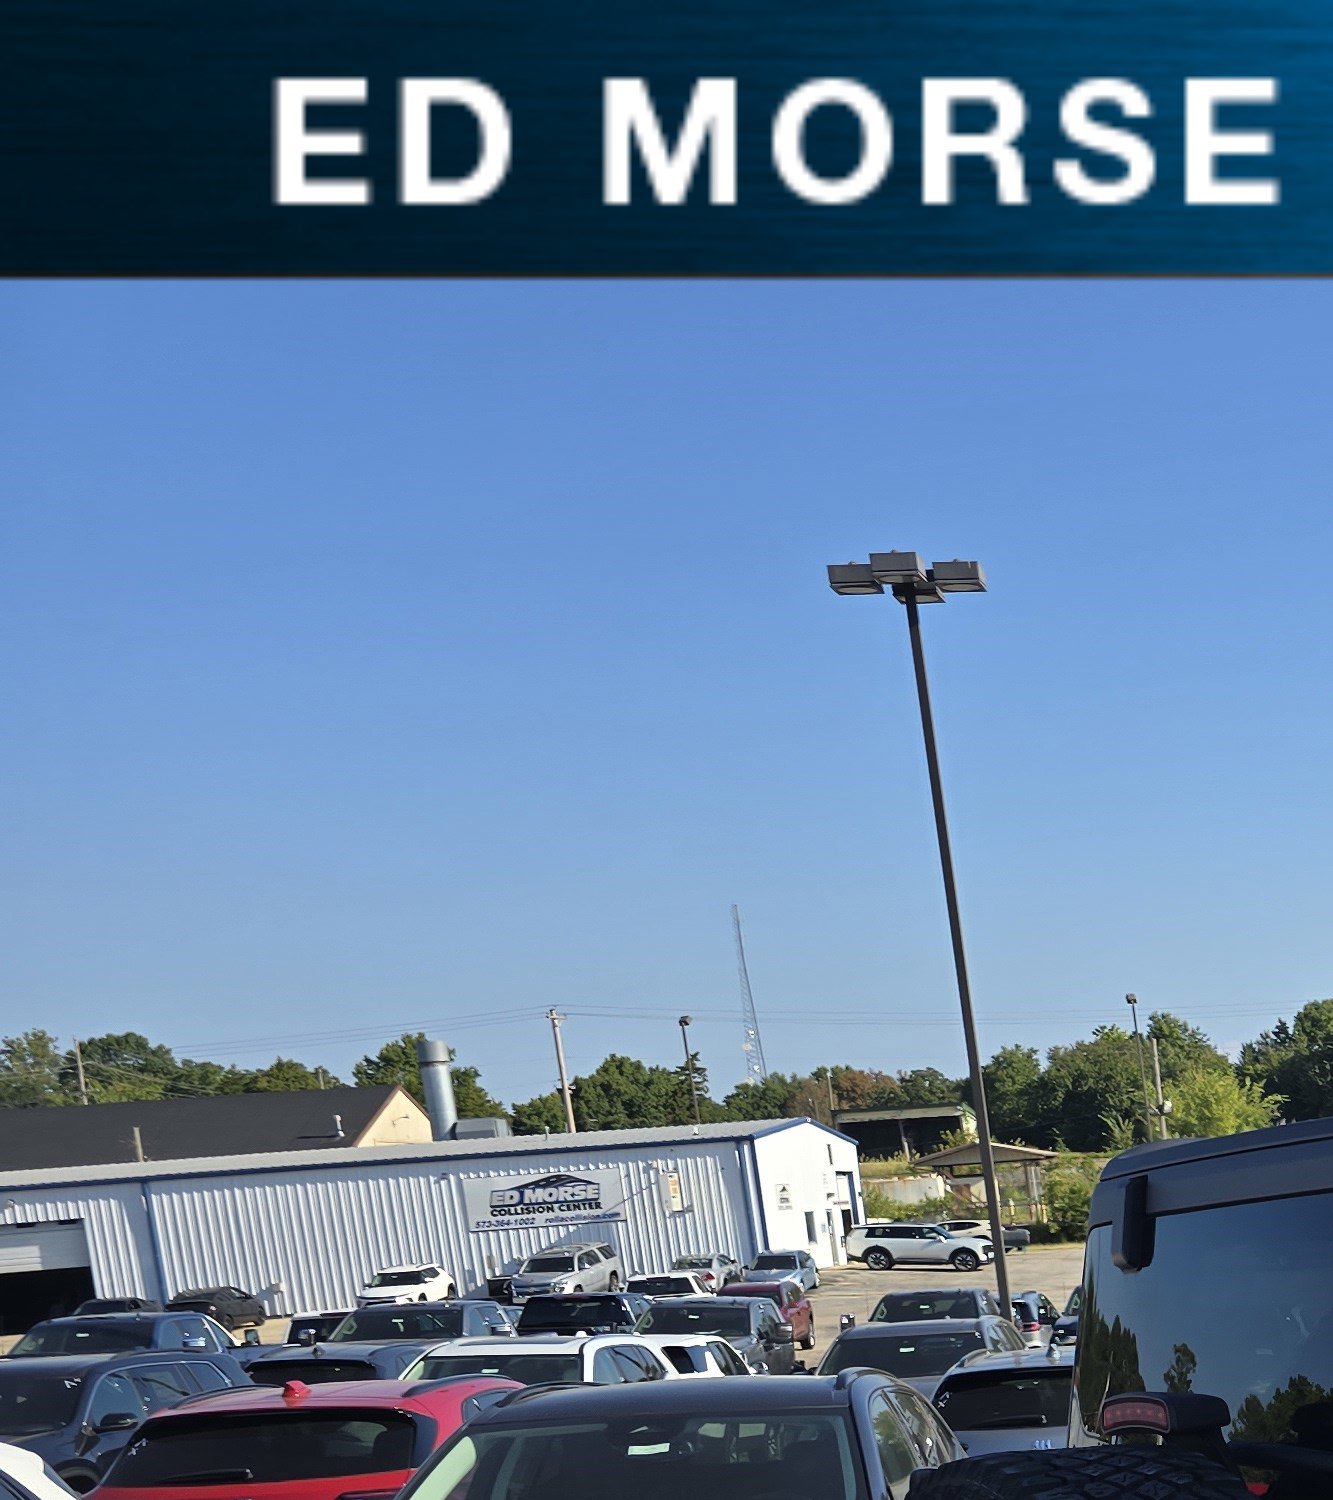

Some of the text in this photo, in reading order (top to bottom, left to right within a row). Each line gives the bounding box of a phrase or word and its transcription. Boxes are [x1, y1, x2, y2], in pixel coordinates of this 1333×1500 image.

[490, 1183, 600, 1207] ED MORSE
[490, 1201, 604, 1217] COLLISION CENTER
